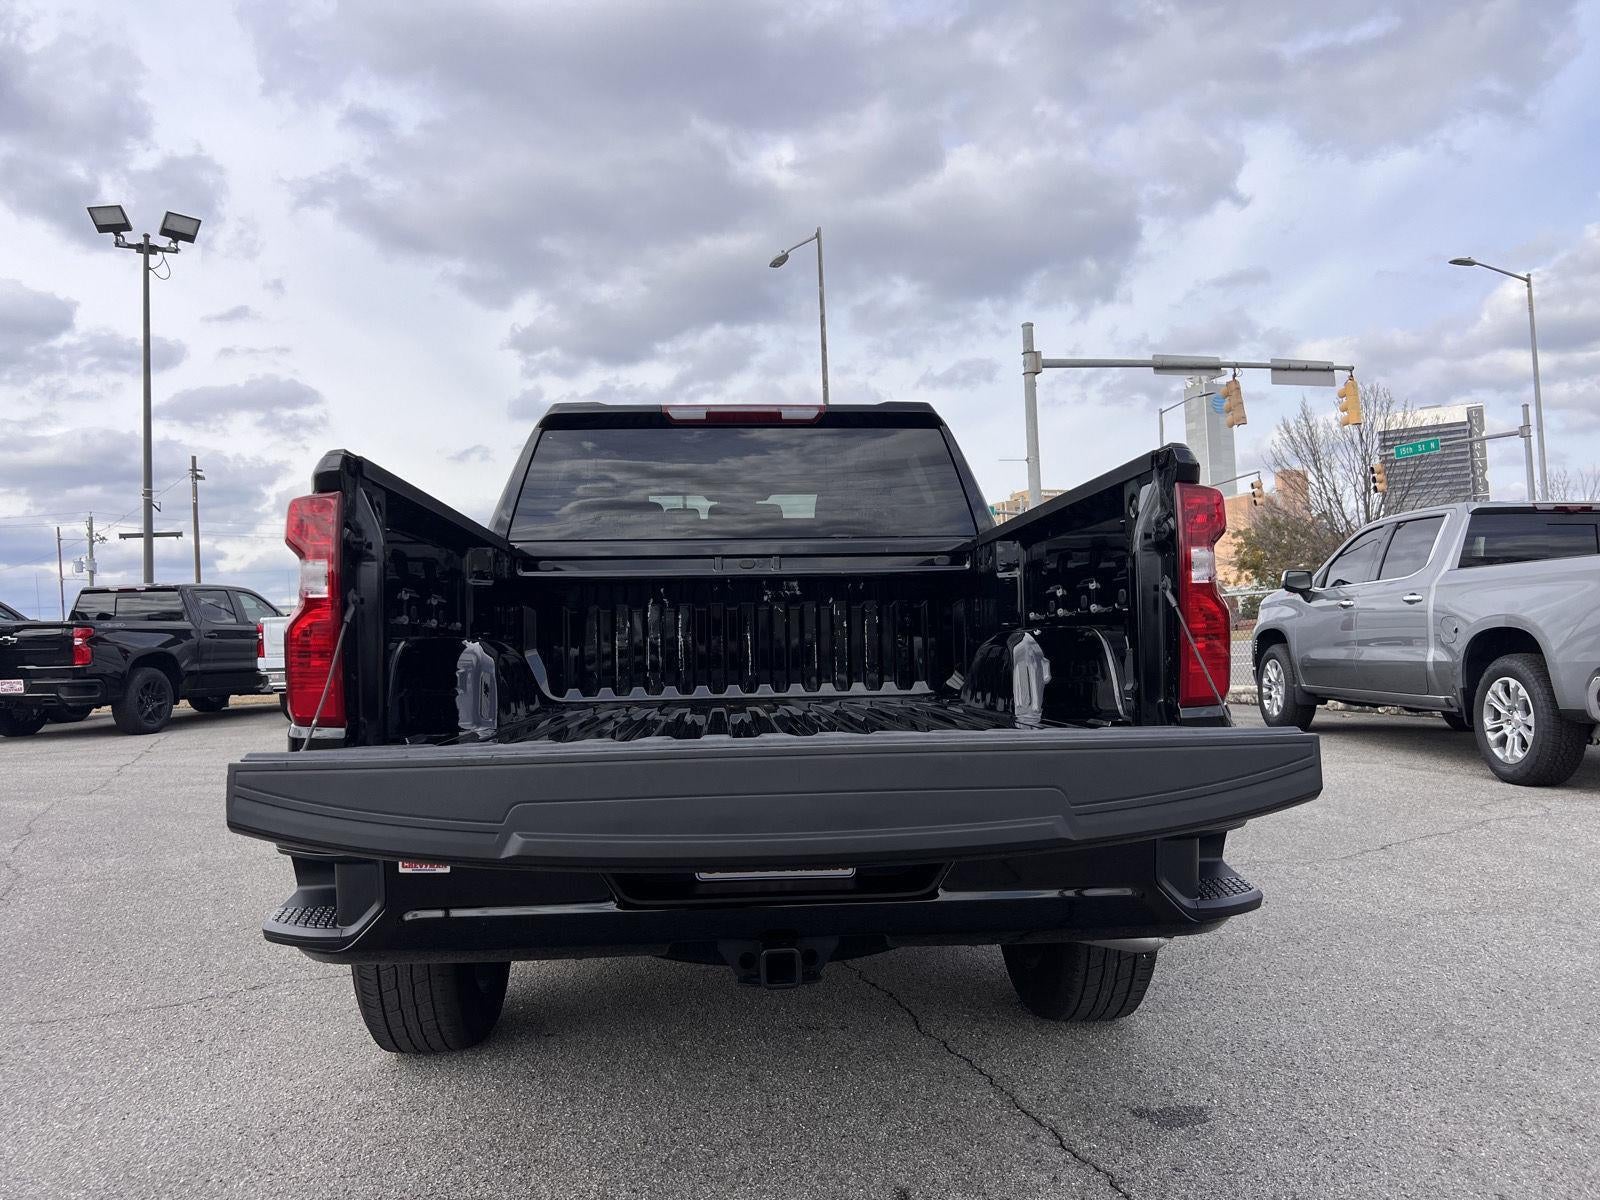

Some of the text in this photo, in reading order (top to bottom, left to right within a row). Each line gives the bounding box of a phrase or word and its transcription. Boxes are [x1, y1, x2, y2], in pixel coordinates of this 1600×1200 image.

[1400, 441, 1436, 456] 15th St N
[1472, 410, 1481, 458] LUXRY
